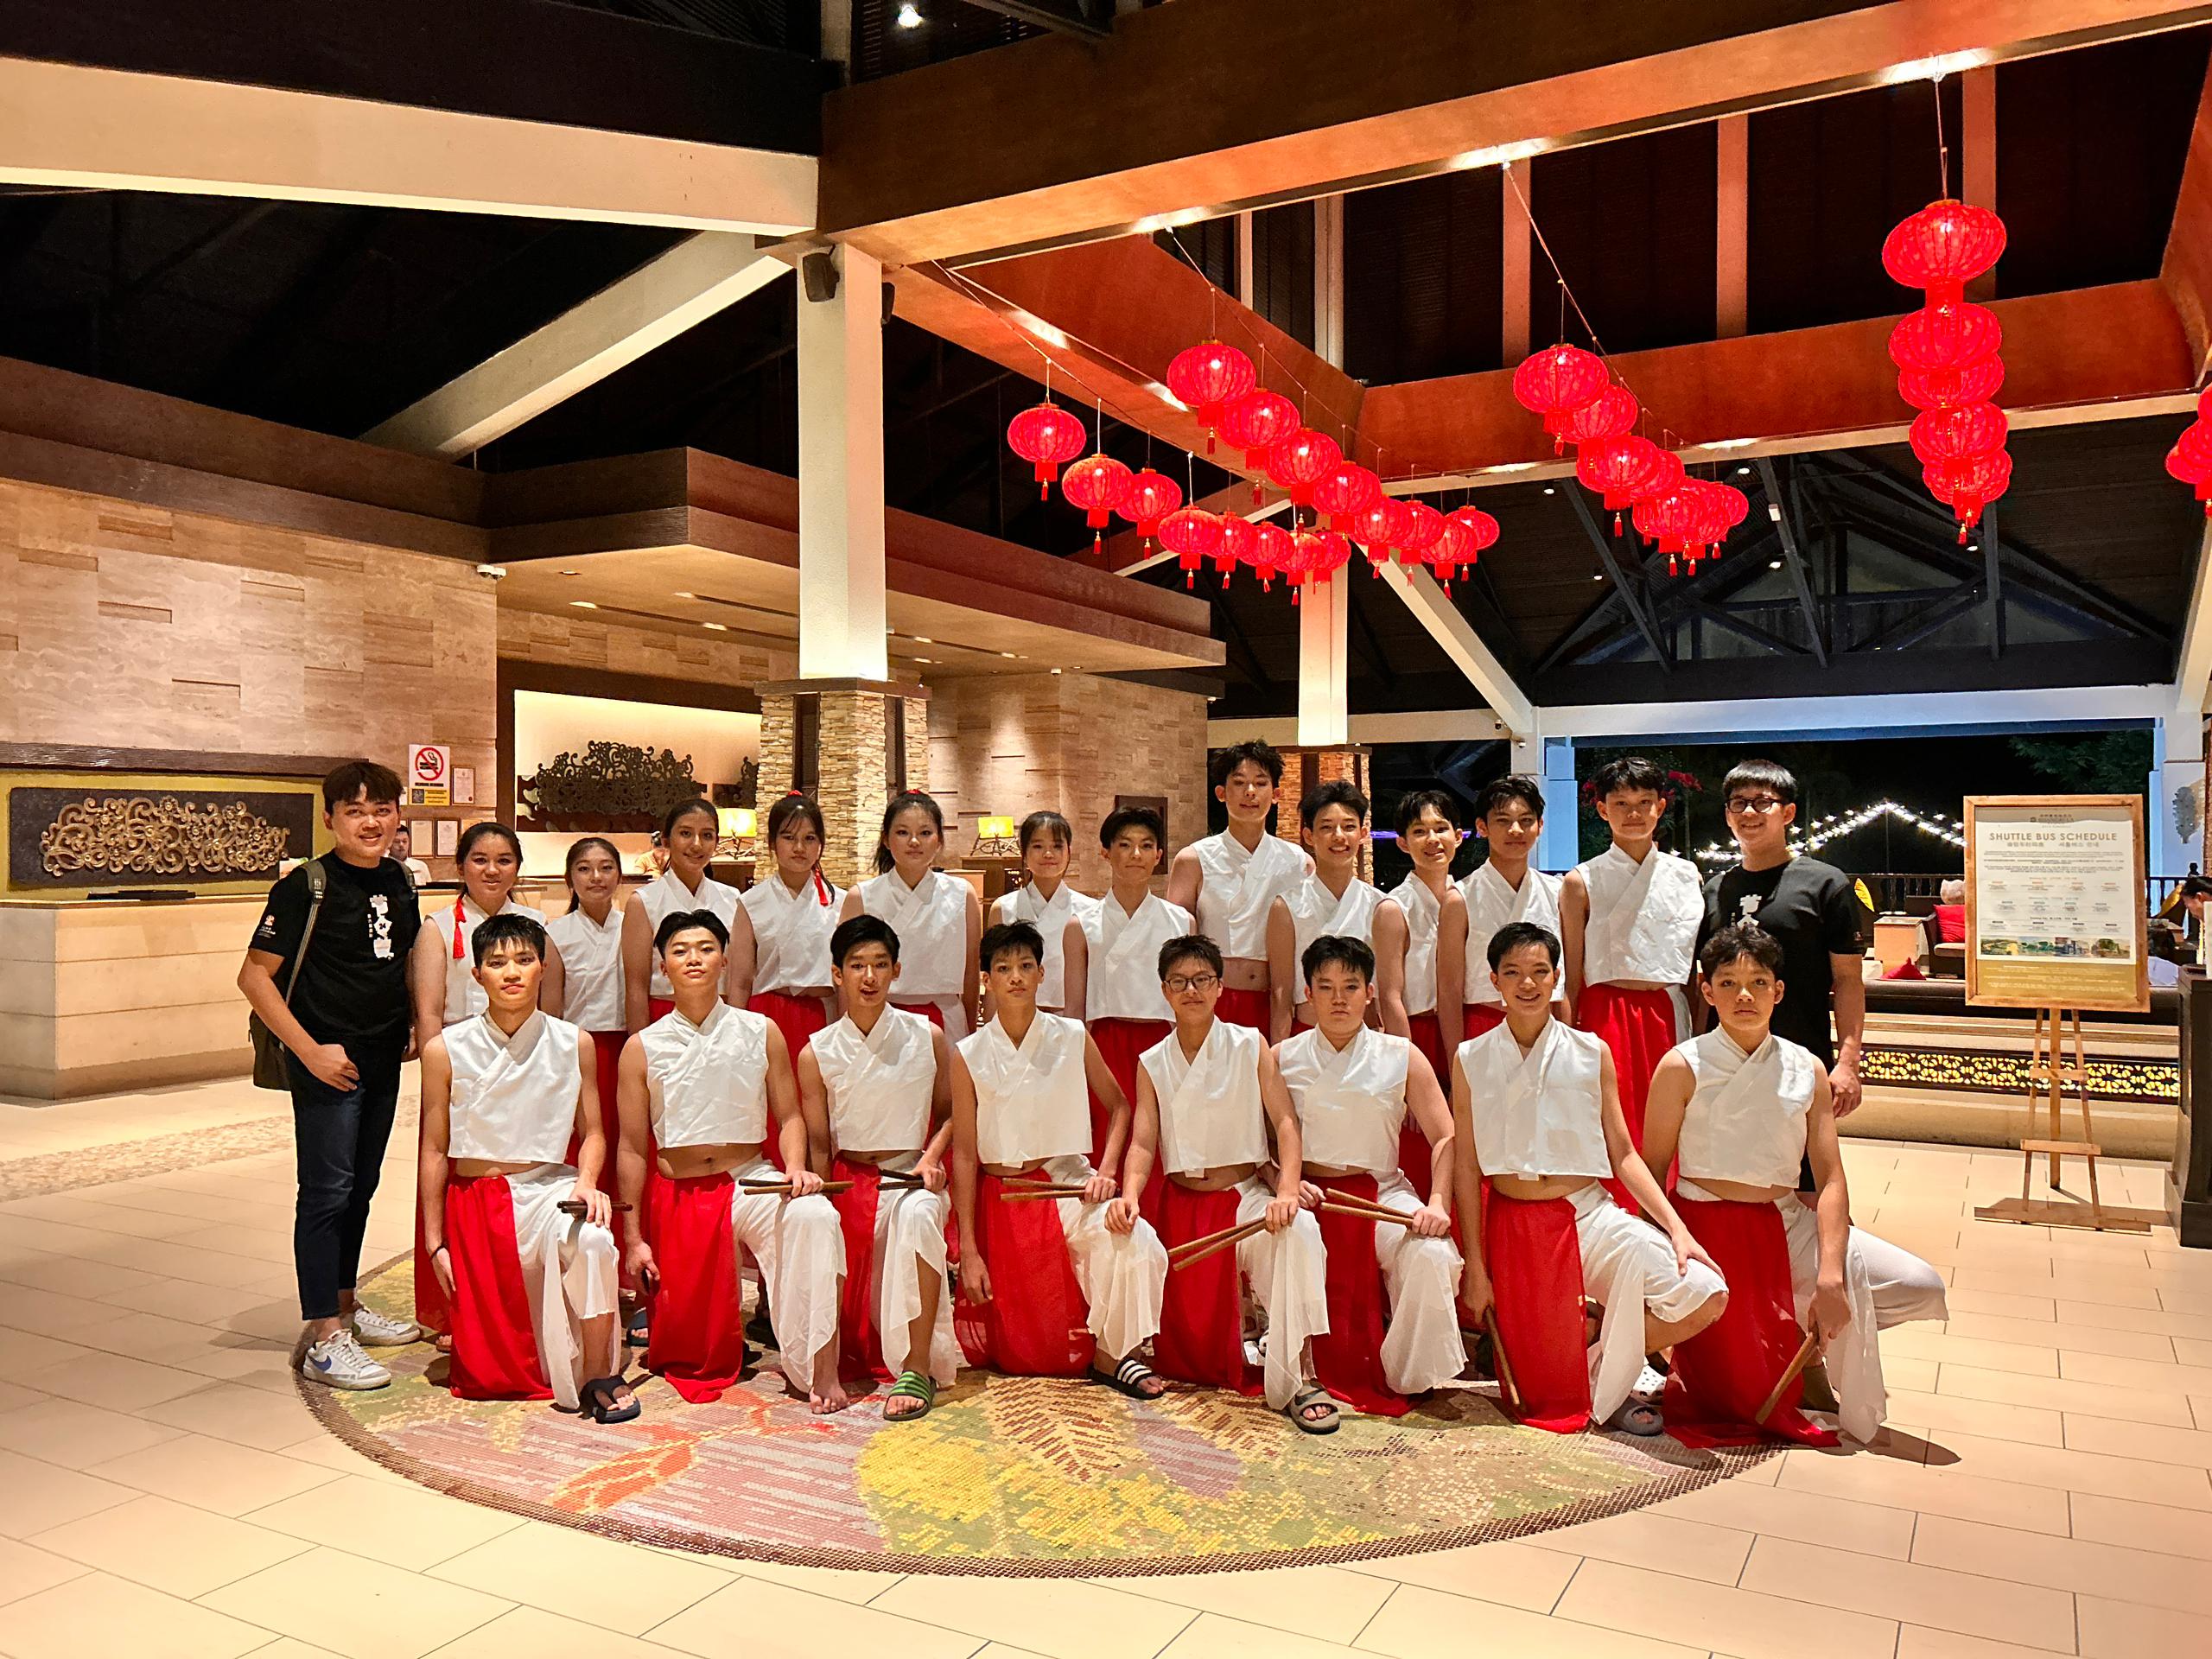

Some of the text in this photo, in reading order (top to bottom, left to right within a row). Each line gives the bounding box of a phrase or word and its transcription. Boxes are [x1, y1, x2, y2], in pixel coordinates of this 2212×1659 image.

[1989, 832, 2117, 841] SHUTTLE BUS SCHEDULE
